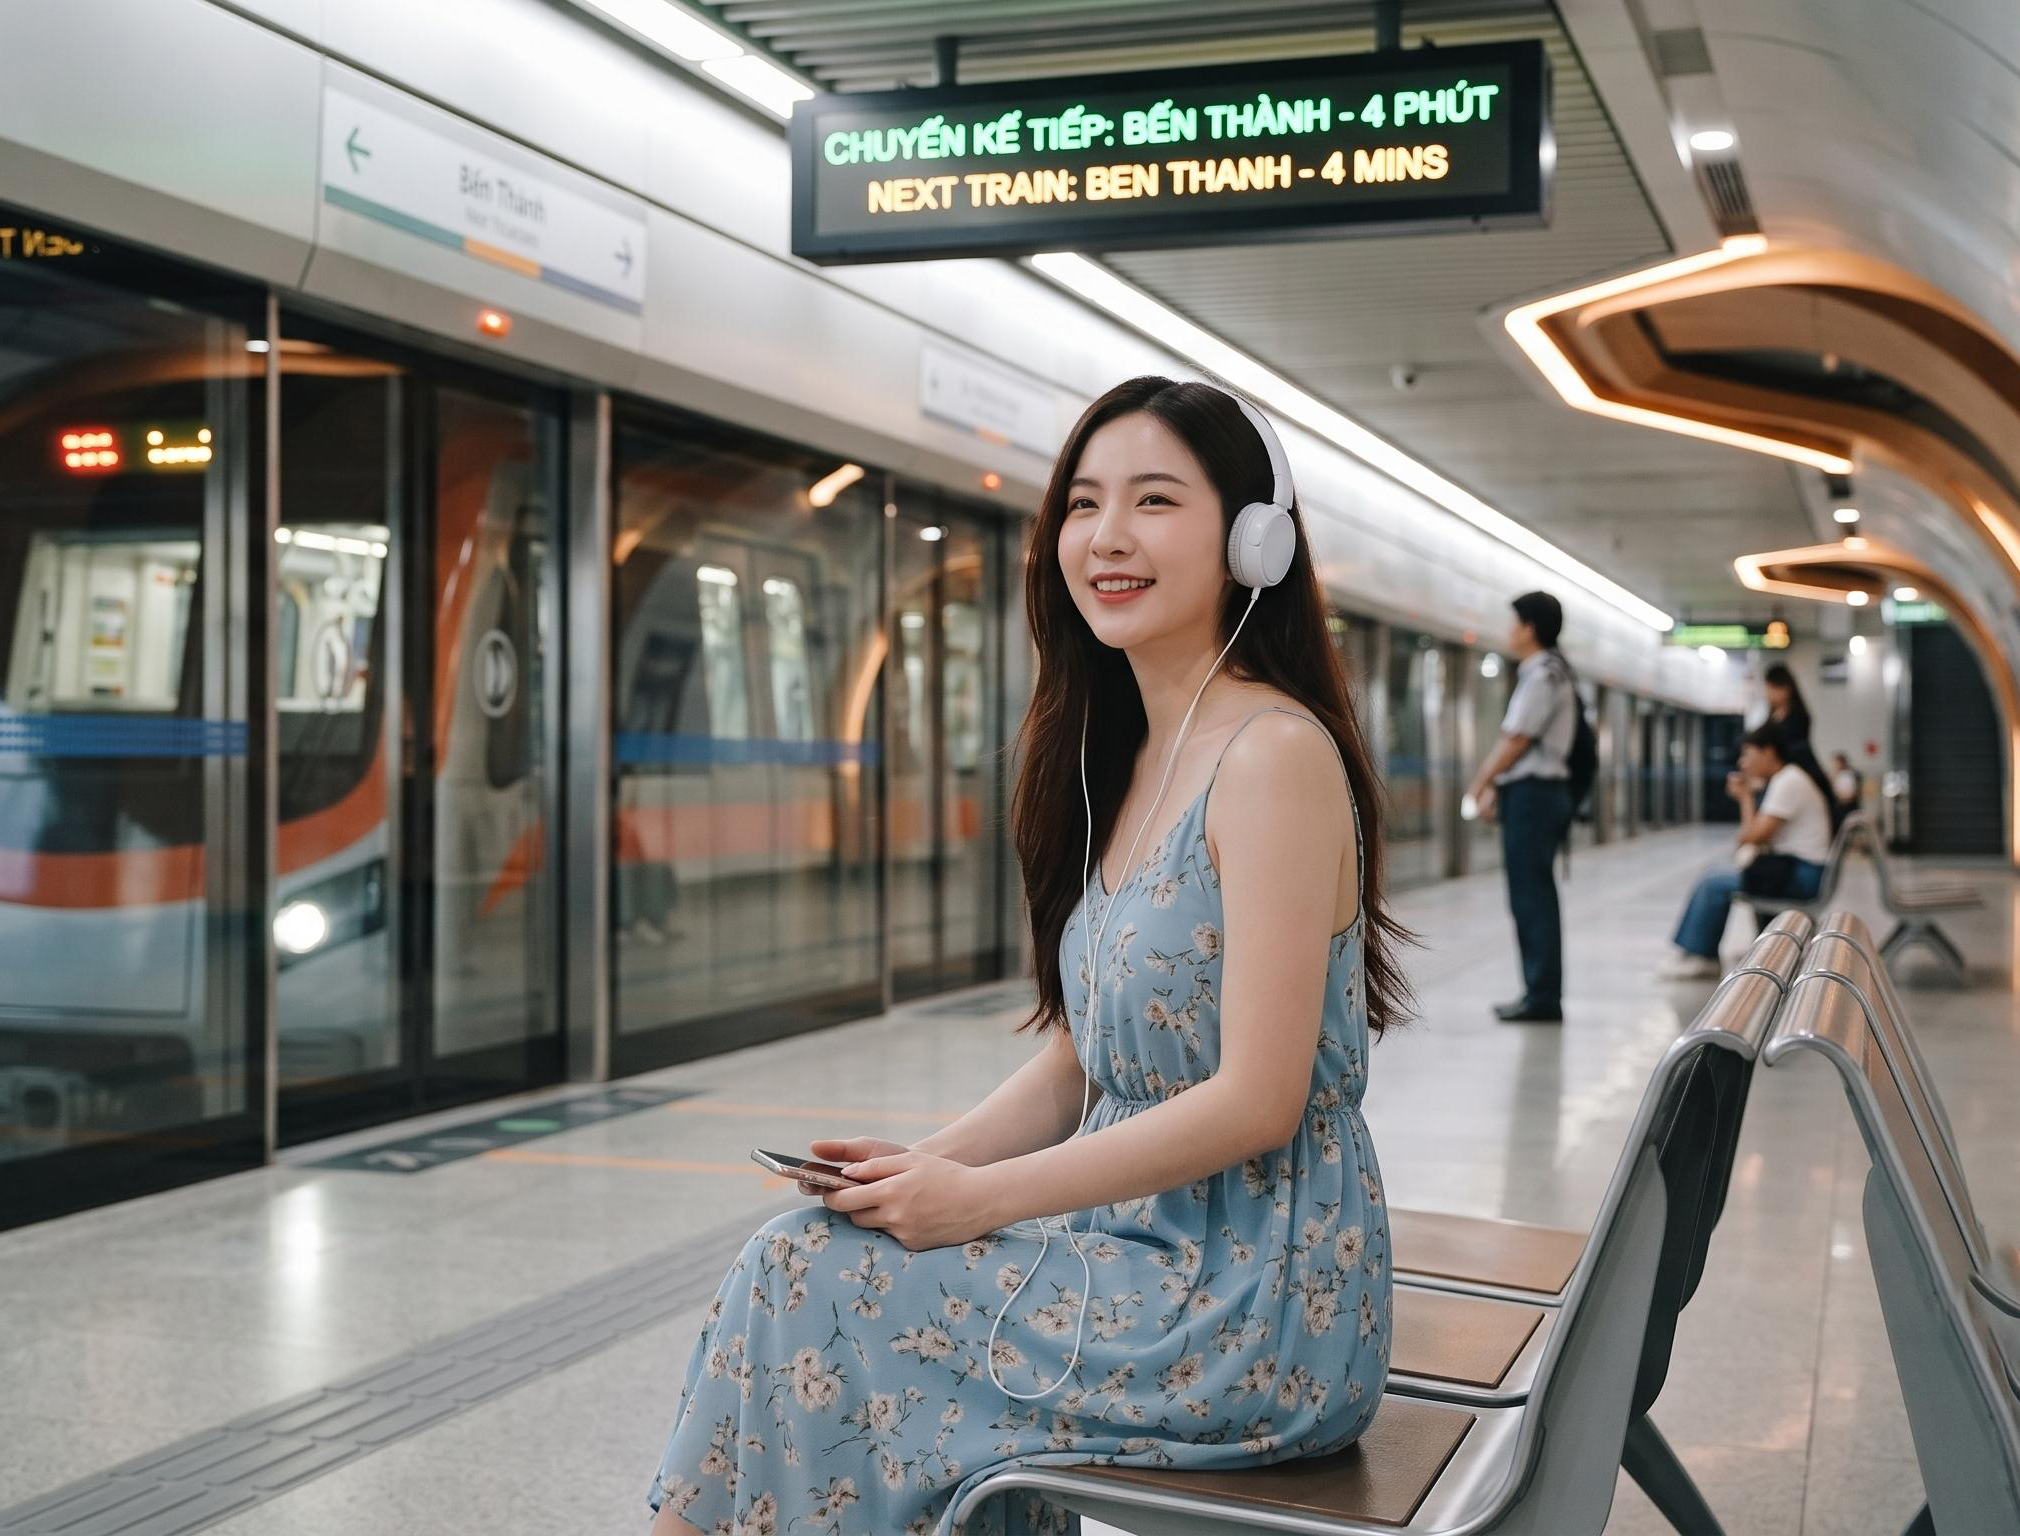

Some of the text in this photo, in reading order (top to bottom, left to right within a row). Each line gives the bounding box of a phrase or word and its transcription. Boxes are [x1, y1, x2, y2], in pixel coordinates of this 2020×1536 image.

[1203, 93, 1331, 140] THÀNH
[1338, 111, 1355, 122] -
[1360, 93, 1387, 129] 4
[1393, 79, 1499, 127] PHÚT
[867, 144, 1449, 214] NEXT TRAIN: BEN THANH - 4 MINS
